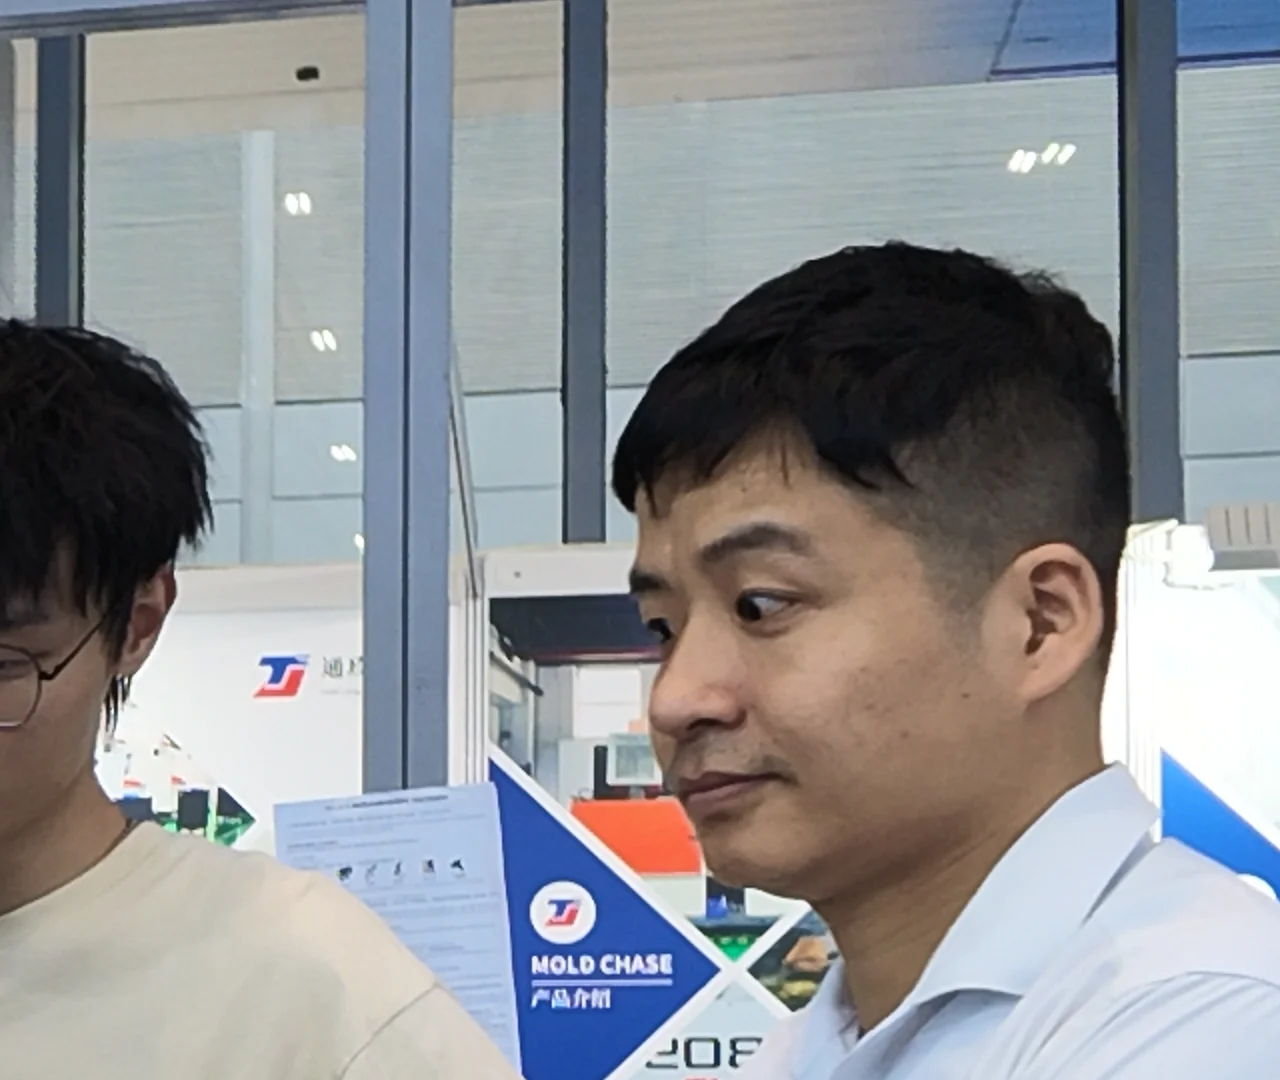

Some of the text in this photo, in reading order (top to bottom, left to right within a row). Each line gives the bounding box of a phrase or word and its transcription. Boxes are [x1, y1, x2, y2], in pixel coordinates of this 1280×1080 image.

[531, 953, 673, 976] MOLD CHASE
[531, 987, 611, 1010] 产品介绍
